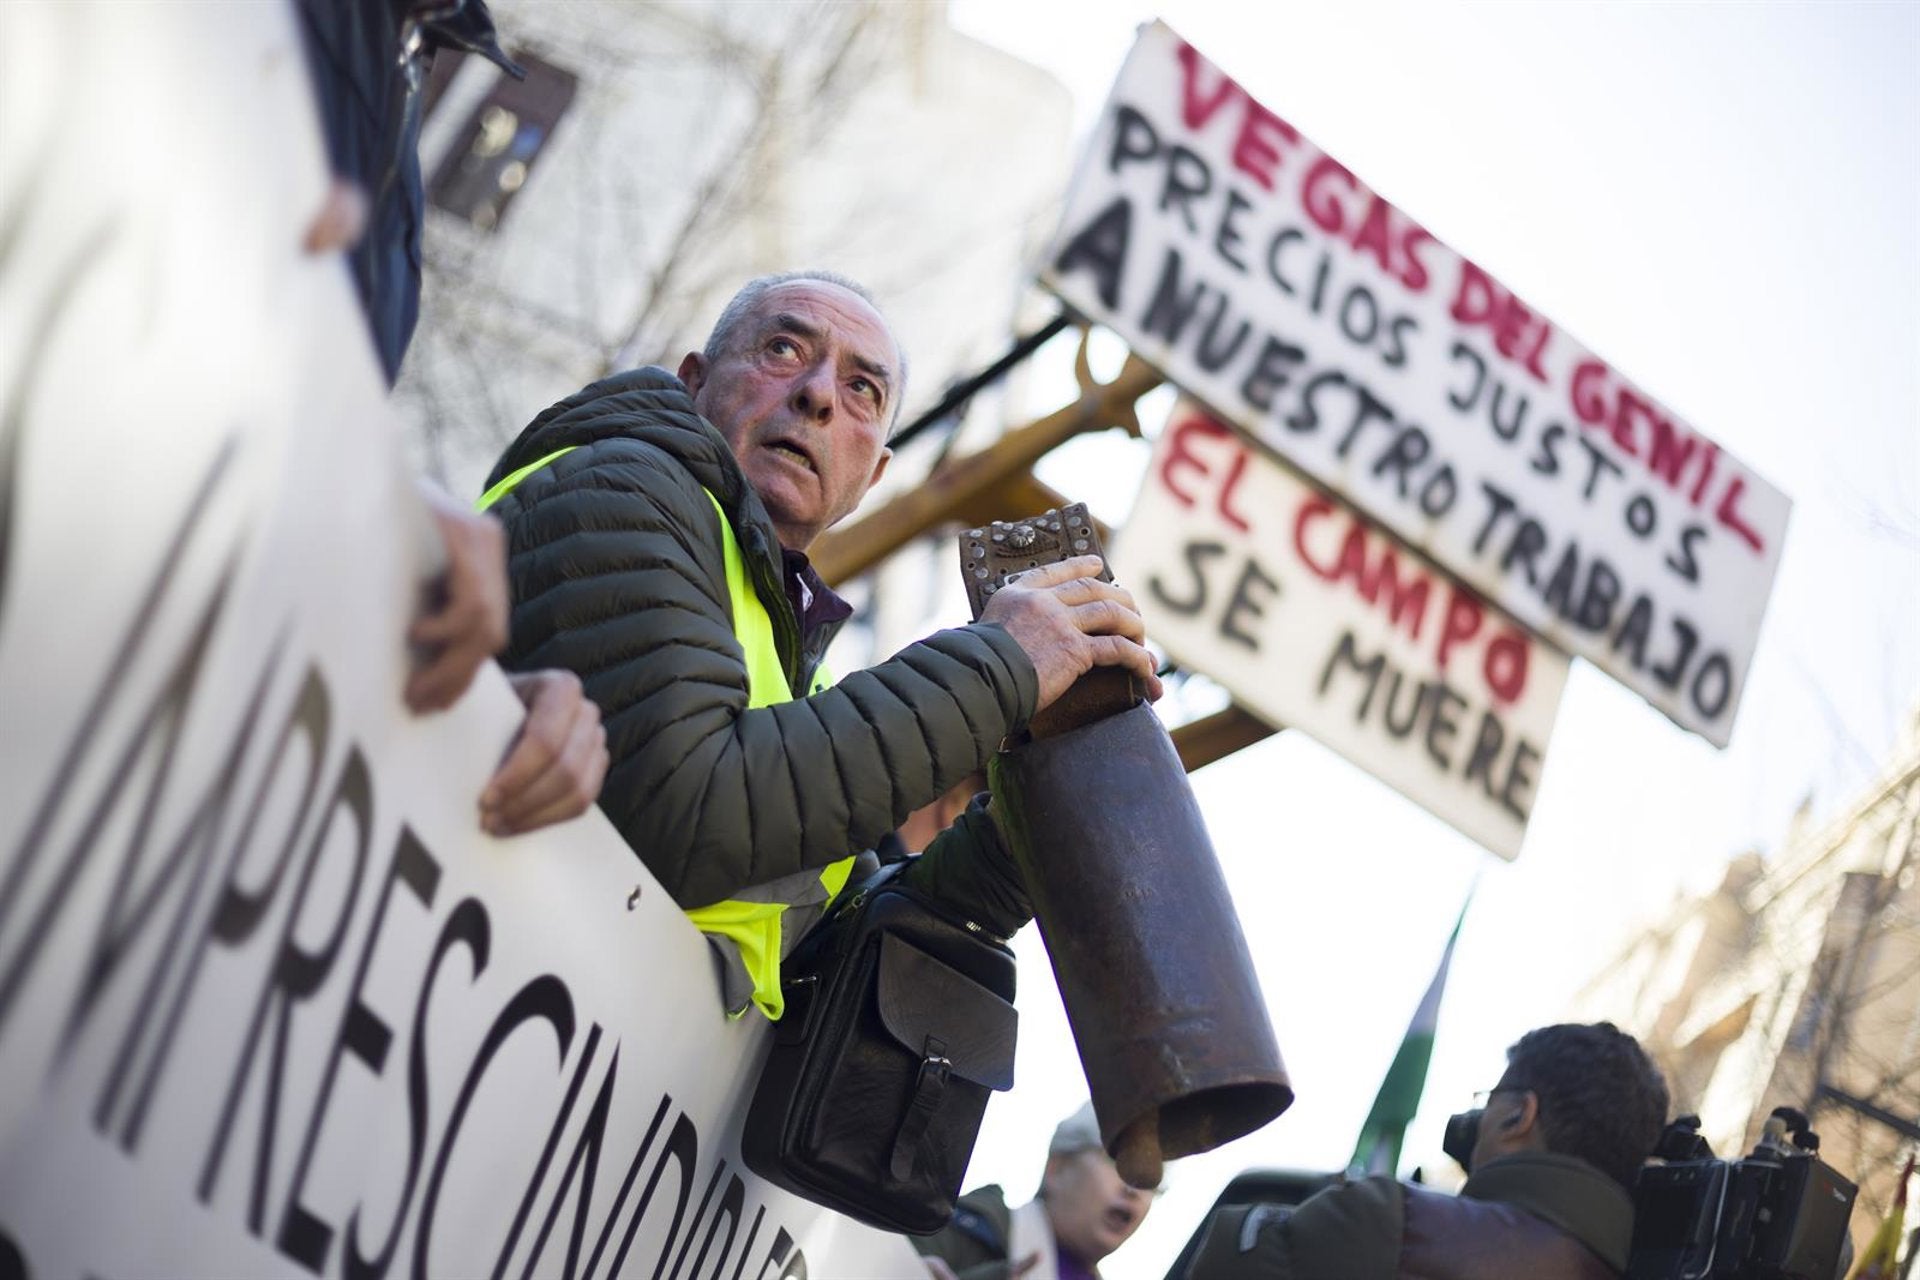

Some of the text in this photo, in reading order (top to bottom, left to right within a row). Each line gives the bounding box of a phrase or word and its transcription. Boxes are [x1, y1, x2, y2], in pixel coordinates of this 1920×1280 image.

[1056, 198, 1734, 722] A NUESTRO TRABAJO
[1108, 104, 1711, 587] PRECIOS JUSTOS
[1175, 40, 1765, 556] VEGAS DEL GENIL
[1147, 537, 1542, 824] SE MUERE
[1158, 412, 1532, 706] EL CAMPO
[0, 428, 808, 1280] IMPRESCINDI
